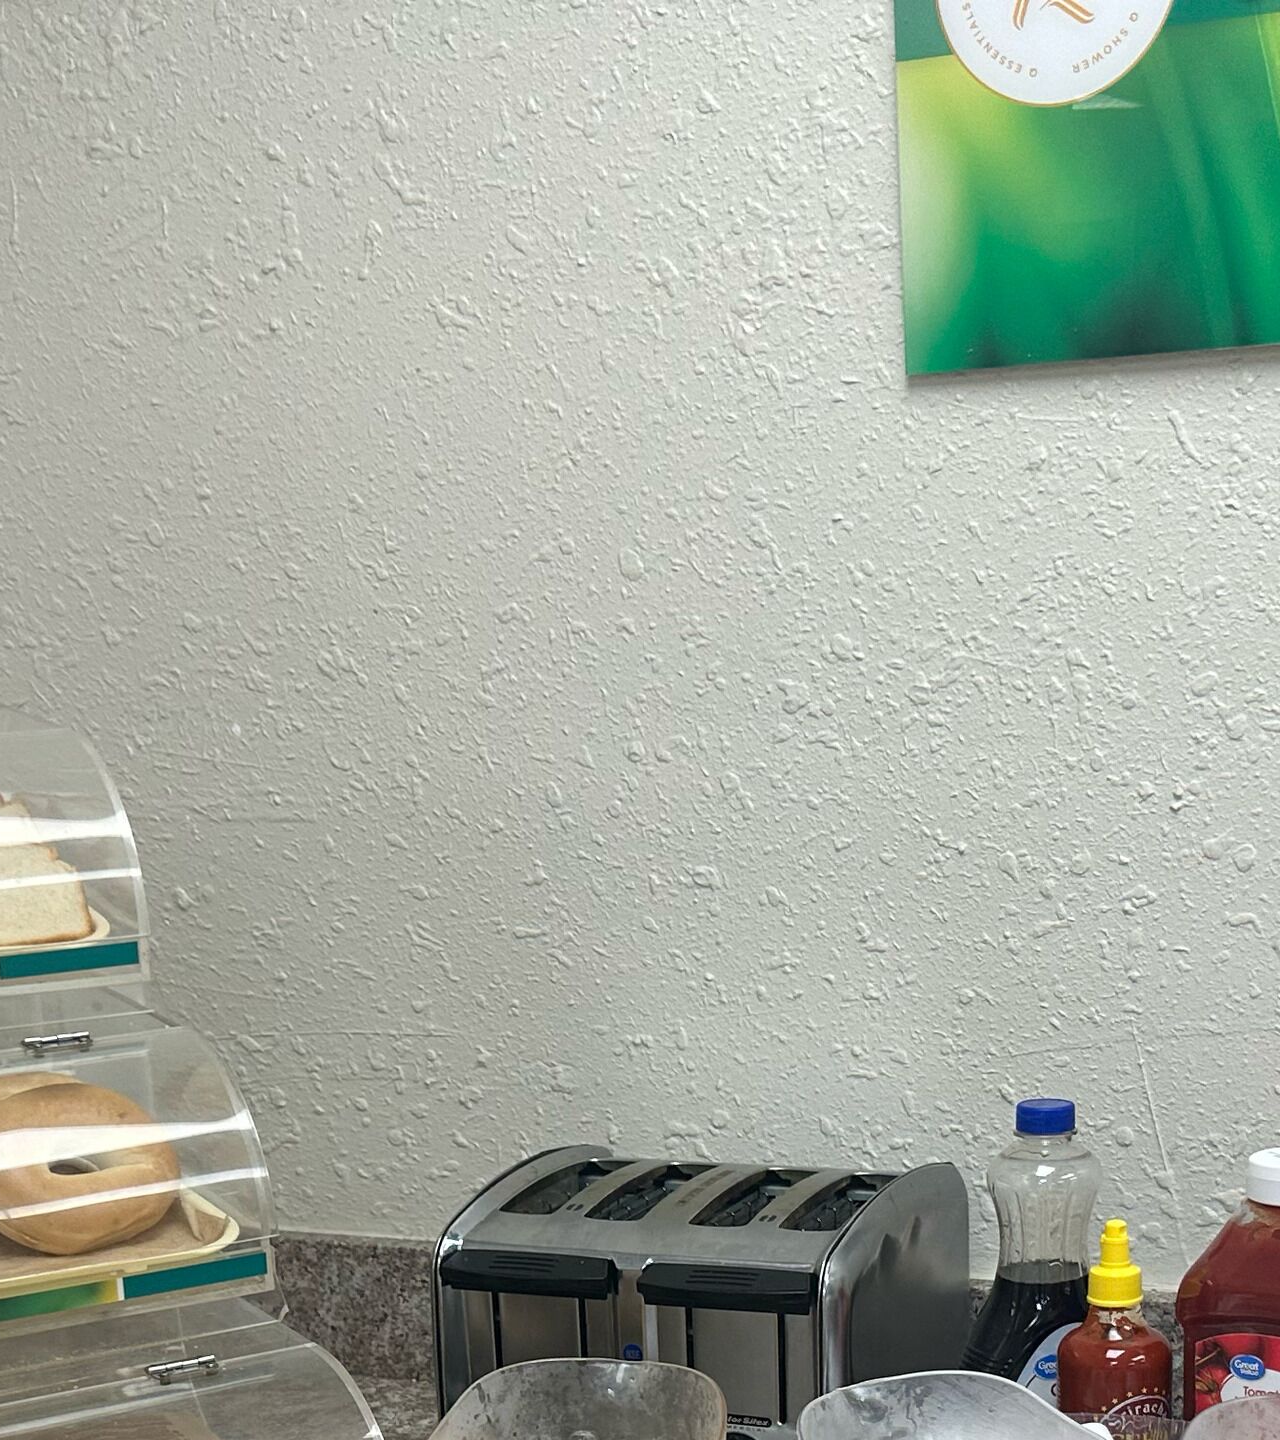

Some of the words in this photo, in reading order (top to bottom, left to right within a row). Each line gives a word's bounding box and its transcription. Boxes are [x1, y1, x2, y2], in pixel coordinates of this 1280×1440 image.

[1129, 12, 1139, 23] Q
[962, 2, 1023, 74] ESSENTIALS
[1072, 27, 1129, 74] SHOWER
[1028, 67, 1038, 78] Q
[1234, 1359, 1260, 1371] Great
